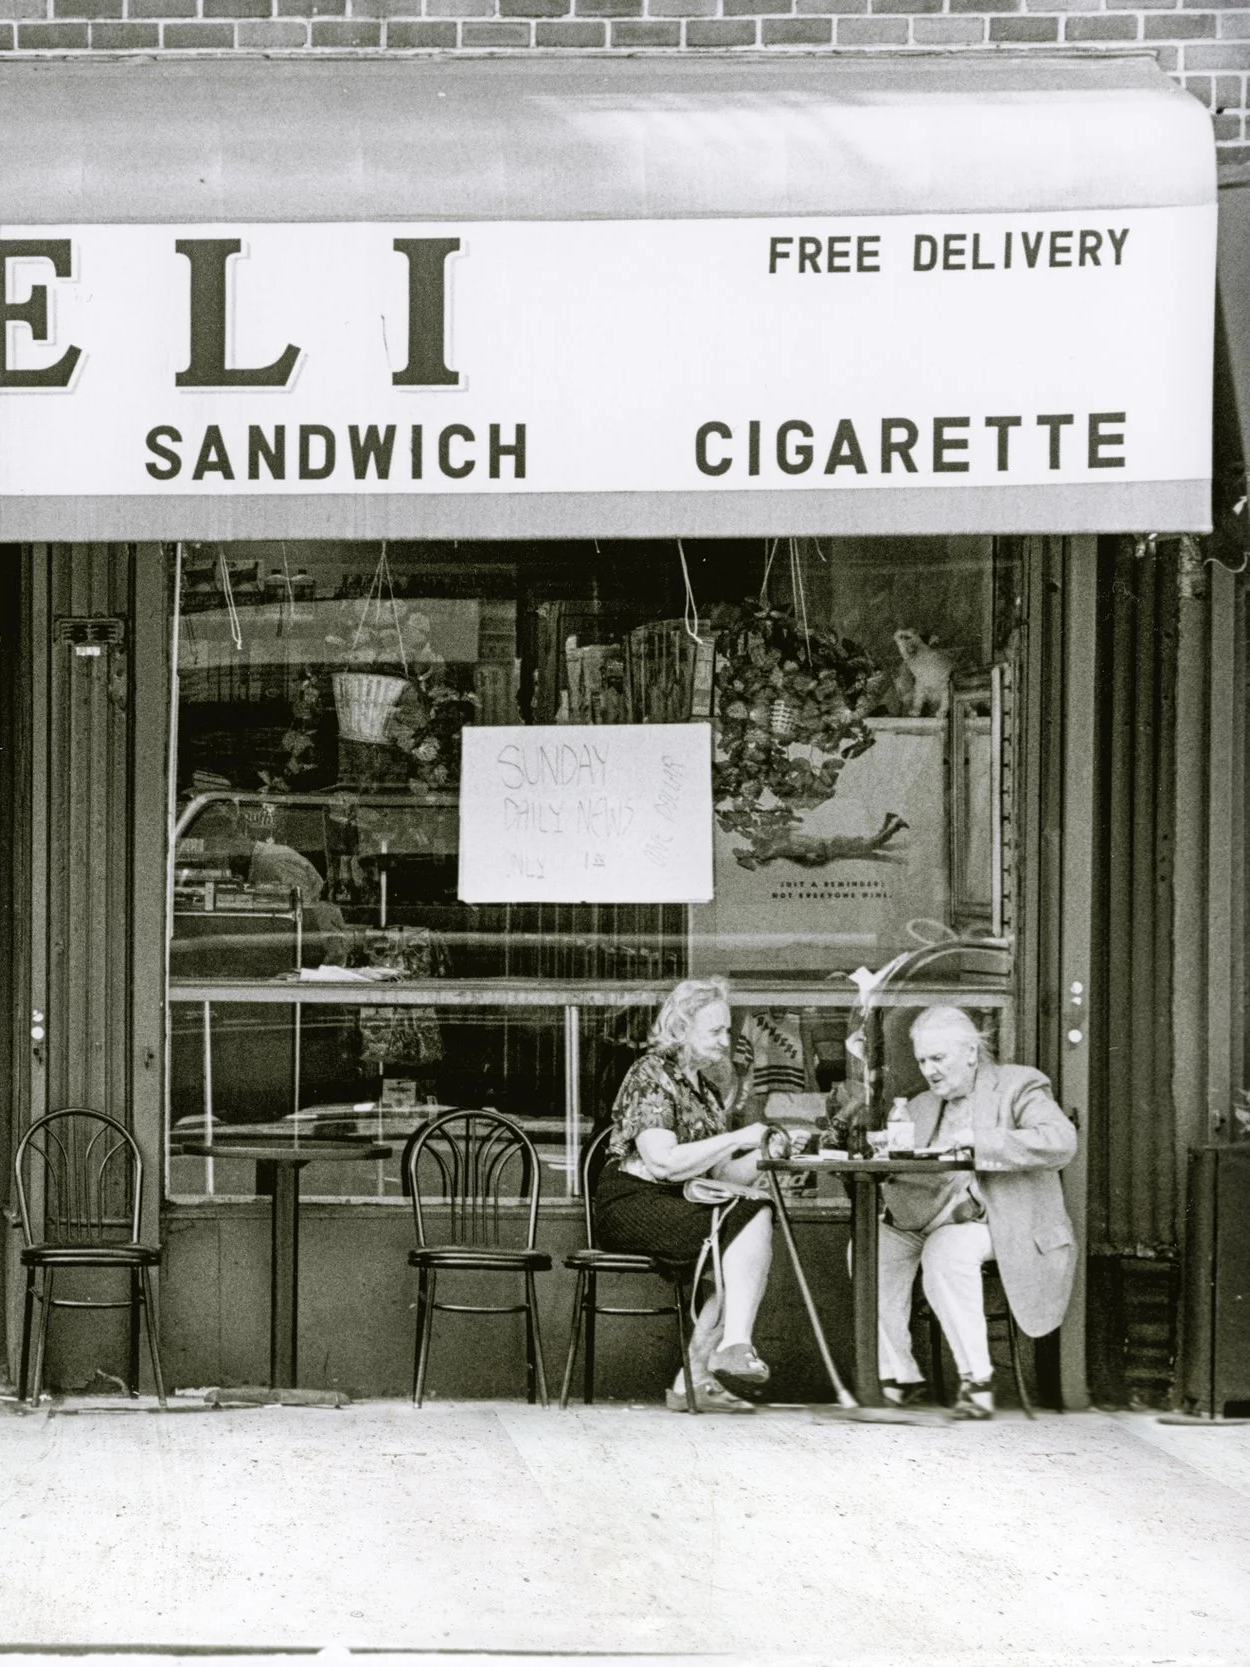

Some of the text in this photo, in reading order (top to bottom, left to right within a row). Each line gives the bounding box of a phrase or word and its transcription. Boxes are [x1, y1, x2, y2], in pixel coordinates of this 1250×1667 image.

[770, 230, 1128, 273] FREE DELIVERY
[146, 424, 525, 480] SANDWICH
[696, 413, 1125, 476] CIGARETTE
[496, 742, 610, 790] SUNDAY
[502, 795, 635, 838] DAILY NEWS
